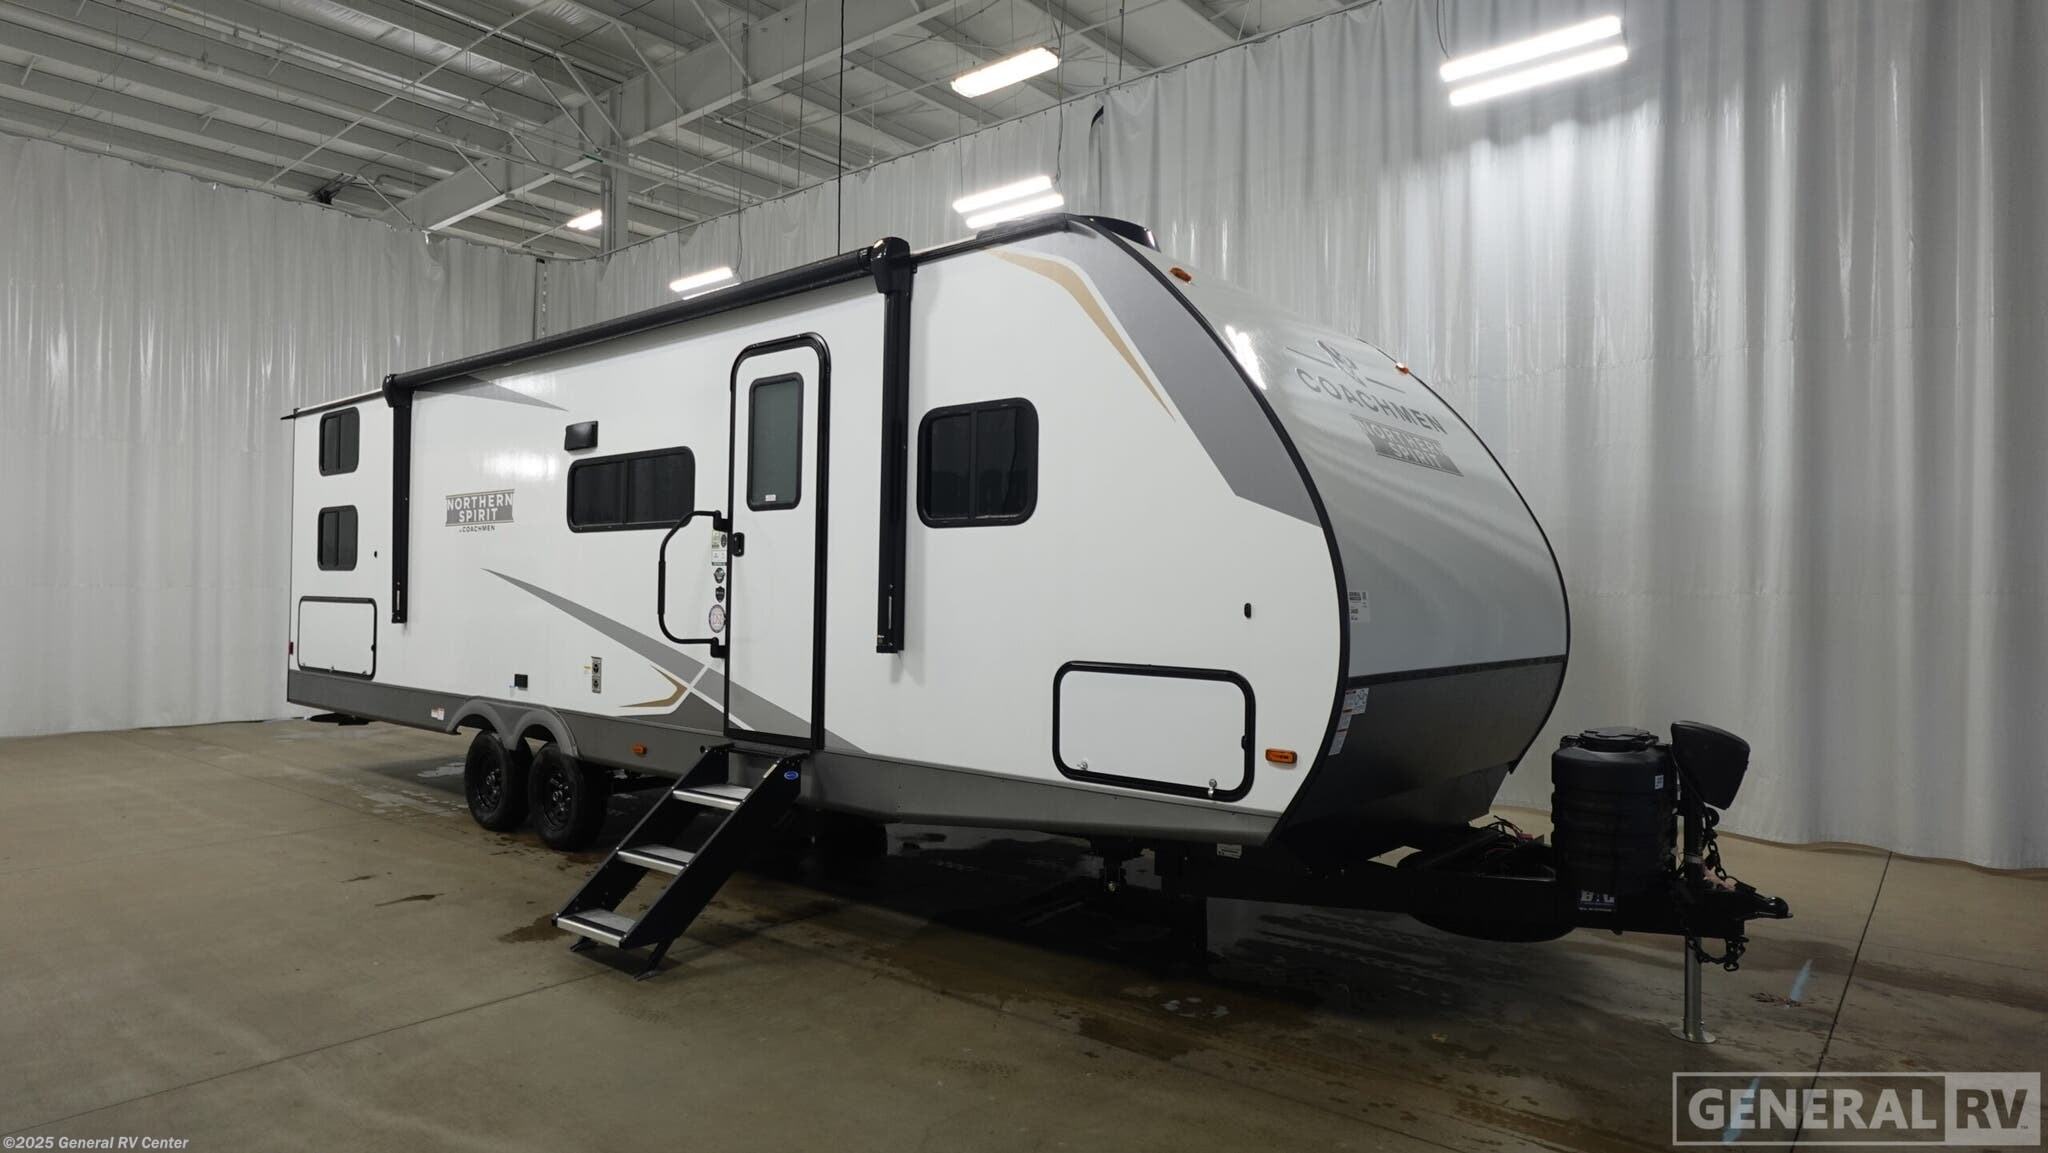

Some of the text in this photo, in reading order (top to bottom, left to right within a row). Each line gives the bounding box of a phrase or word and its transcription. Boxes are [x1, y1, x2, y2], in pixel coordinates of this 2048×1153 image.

[1295, 367, 1448, 435] COACHMEN
[1387, 441, 1442, 468] SPIRIT
[447, 493, 513, 511] NORTHERN
[458, 507, 498, 523] SPIRIT
[462, 525, 496, 533] COACHMEN
